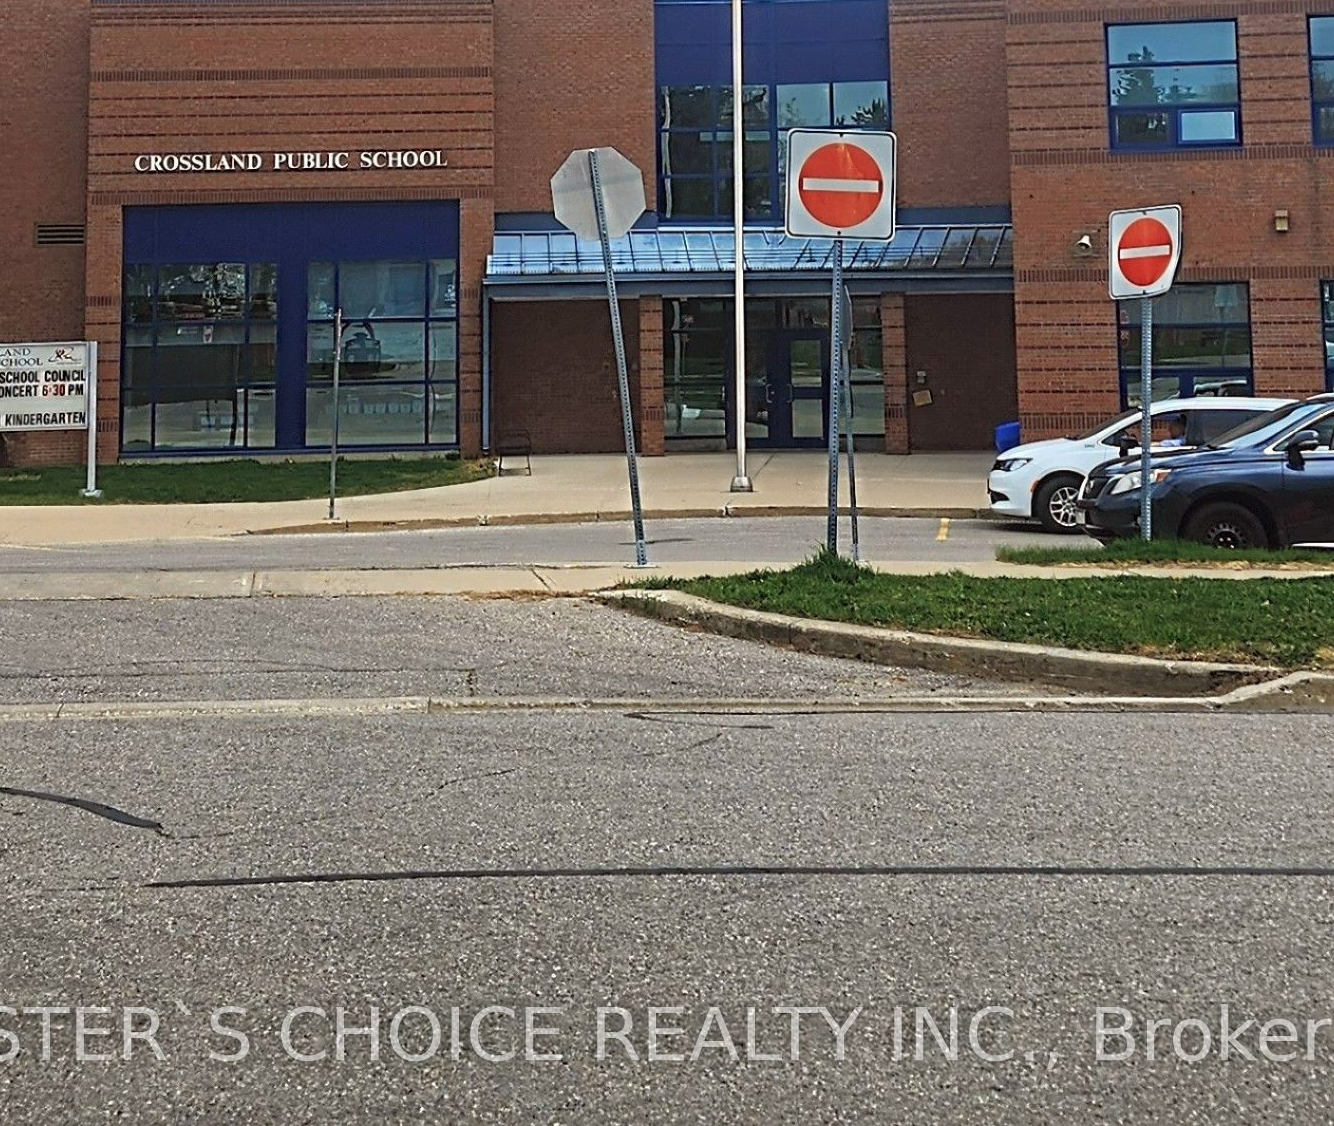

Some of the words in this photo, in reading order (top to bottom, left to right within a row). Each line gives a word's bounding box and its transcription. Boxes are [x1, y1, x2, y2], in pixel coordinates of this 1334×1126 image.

[134, 153, 262, 172] CROSSLAND
[273, 152, 349, 170] PUBLIC
[360, 150, 447, 169] SCHOOL
[0, 370, 40, 384] SCHOOL
[44, 369, 86, 382] COUNCIL
[42, 383, 66, 397] 6:30
[68, 383, 84, 396] PM
[5, 412, 86, 426] KINDERGARTEN
